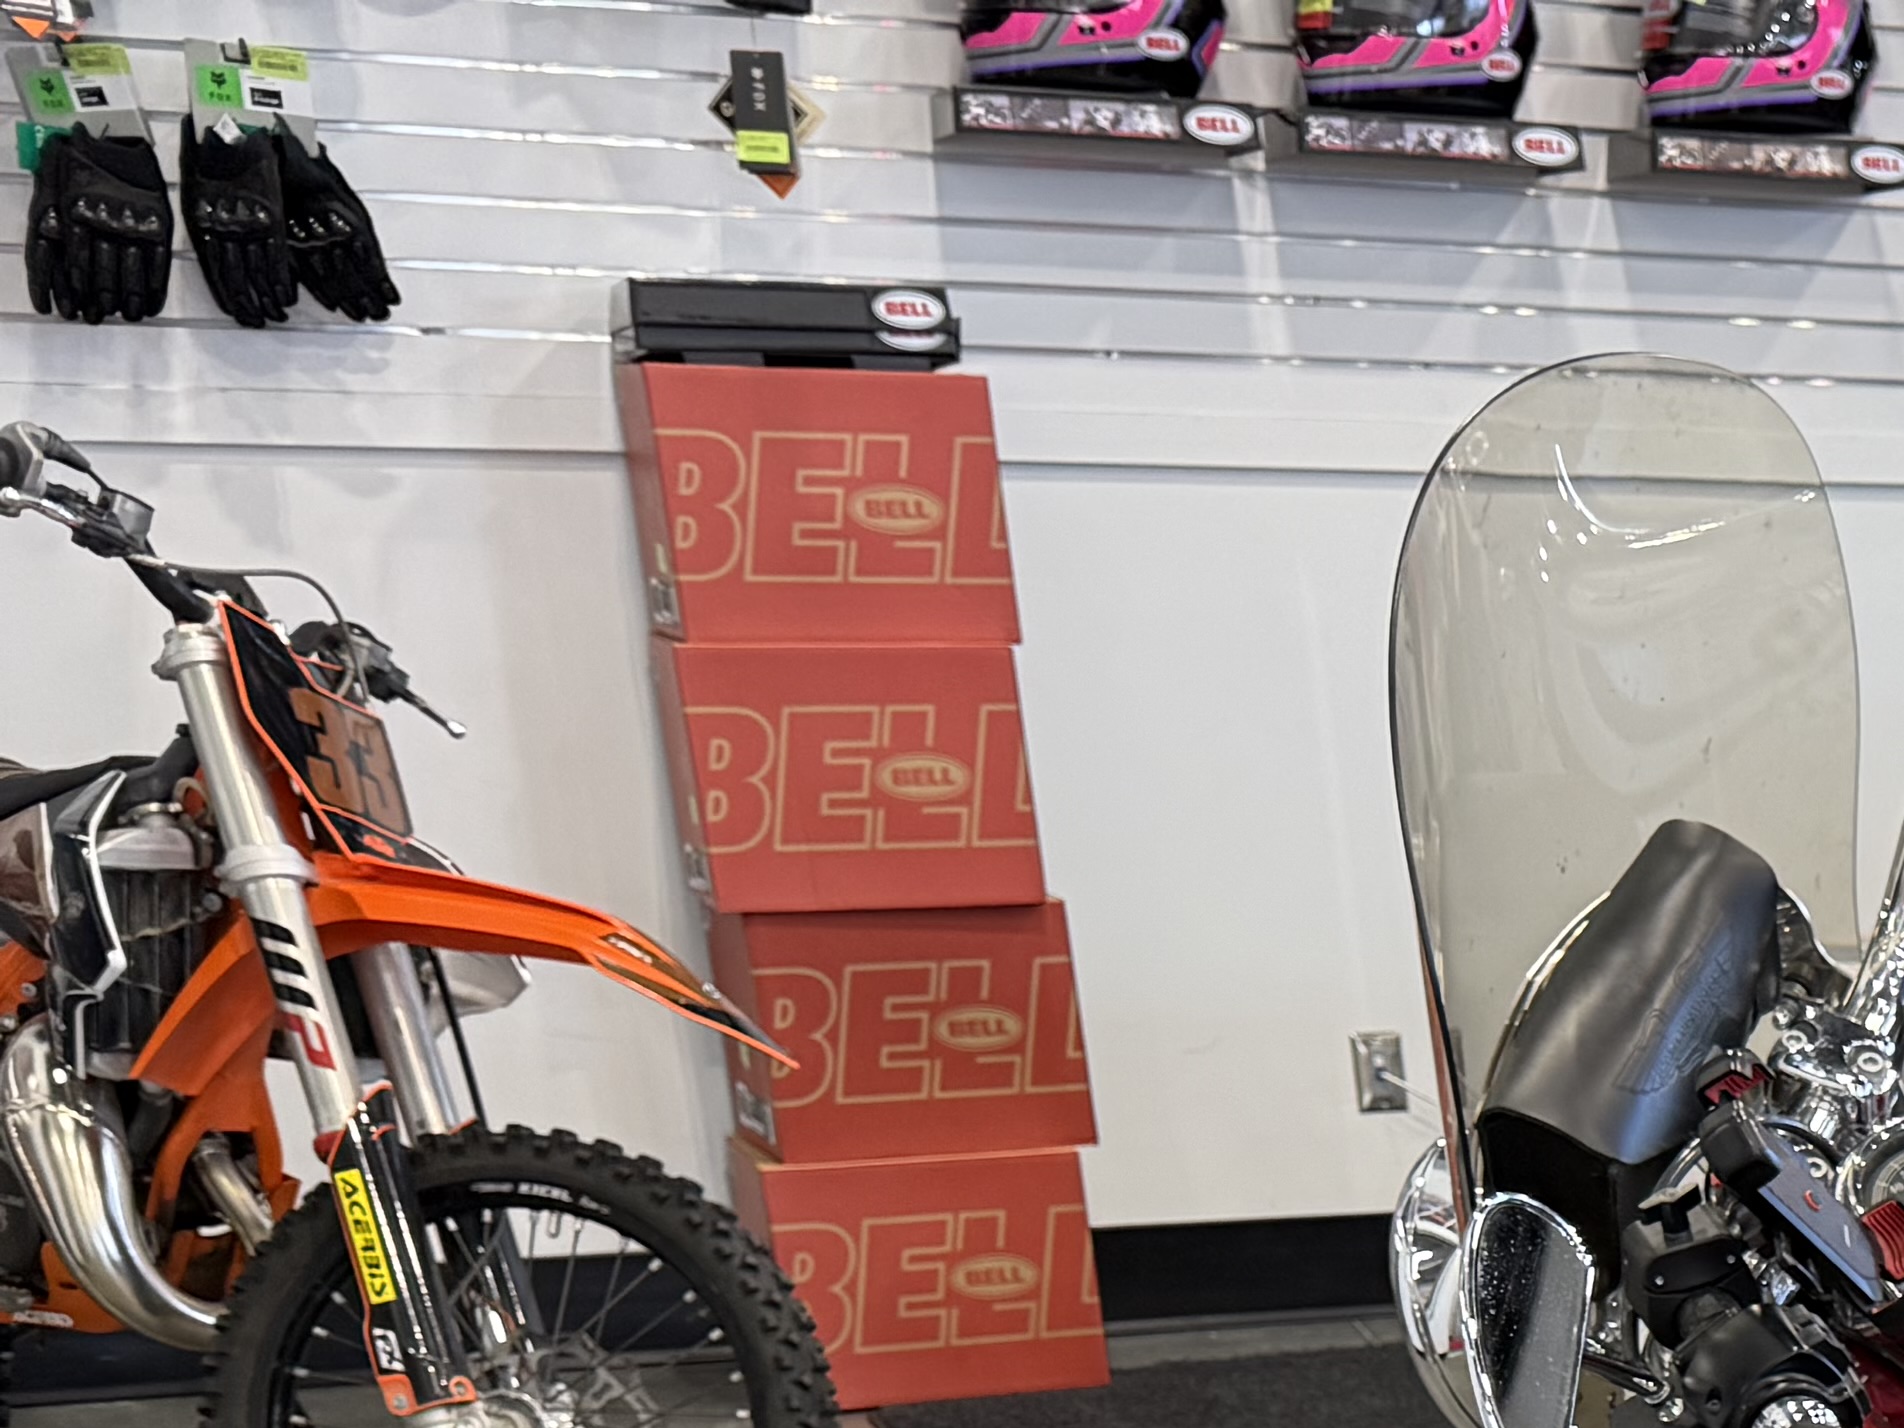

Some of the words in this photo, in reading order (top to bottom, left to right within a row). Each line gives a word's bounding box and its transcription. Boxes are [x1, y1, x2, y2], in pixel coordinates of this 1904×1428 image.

[1196, 116, 1241, 134] BELL
[884, 302, 934, 317] BELL
[654, 428, 1012, 584] BELL
[862, 496, 930, 522] BELL
[289, 688, 411, 835] 33
[684, 705, 1039, 852] BELL
[889, 765, 956, 789] BELL
[947, 1017, 1010, 1039] BELL
[341, 1178, 387, 1298] ACERBIS
